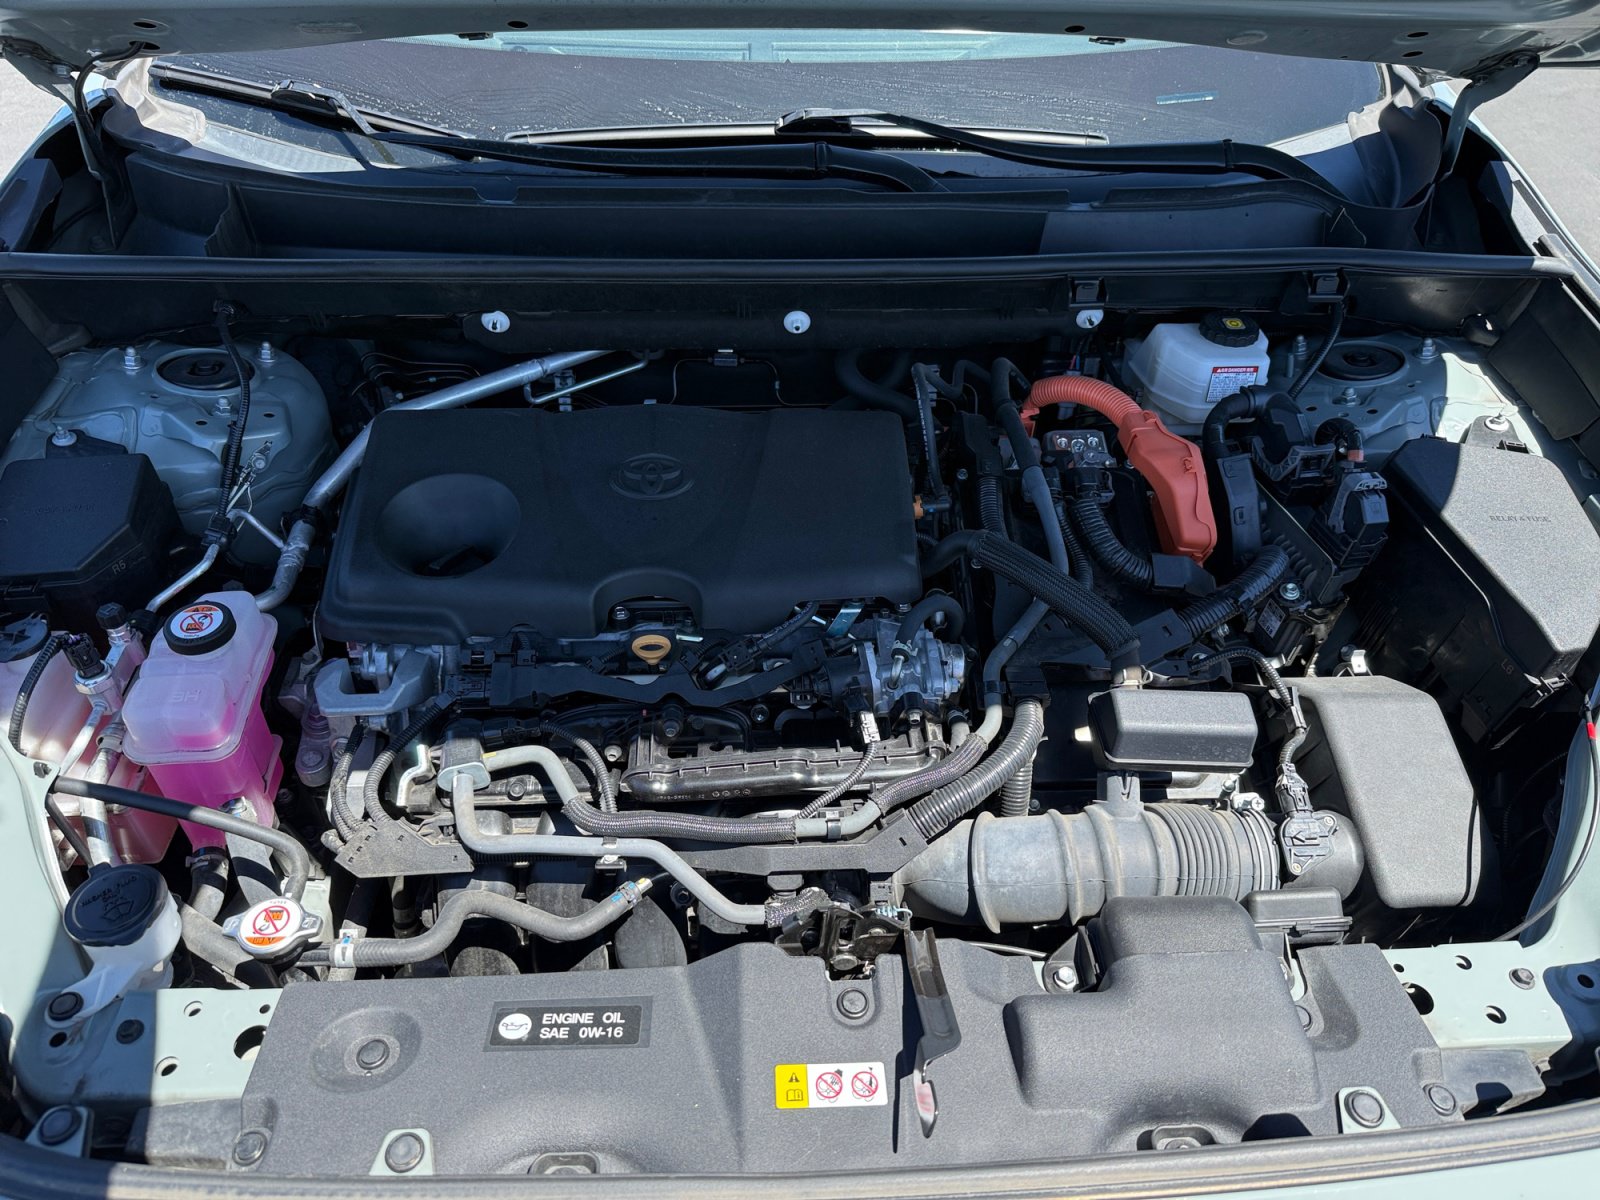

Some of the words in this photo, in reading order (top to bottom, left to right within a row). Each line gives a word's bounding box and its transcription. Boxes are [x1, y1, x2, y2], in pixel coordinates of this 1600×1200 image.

[1526, 515, 1552, 523] FUSE
[542, 1012, 594, 1025] ENGINE
[602, 1011, 625, 1024] OIL
[539, 1027, 570, 1039] SAE
[578, 1026, 624, 1039] 0W-16
